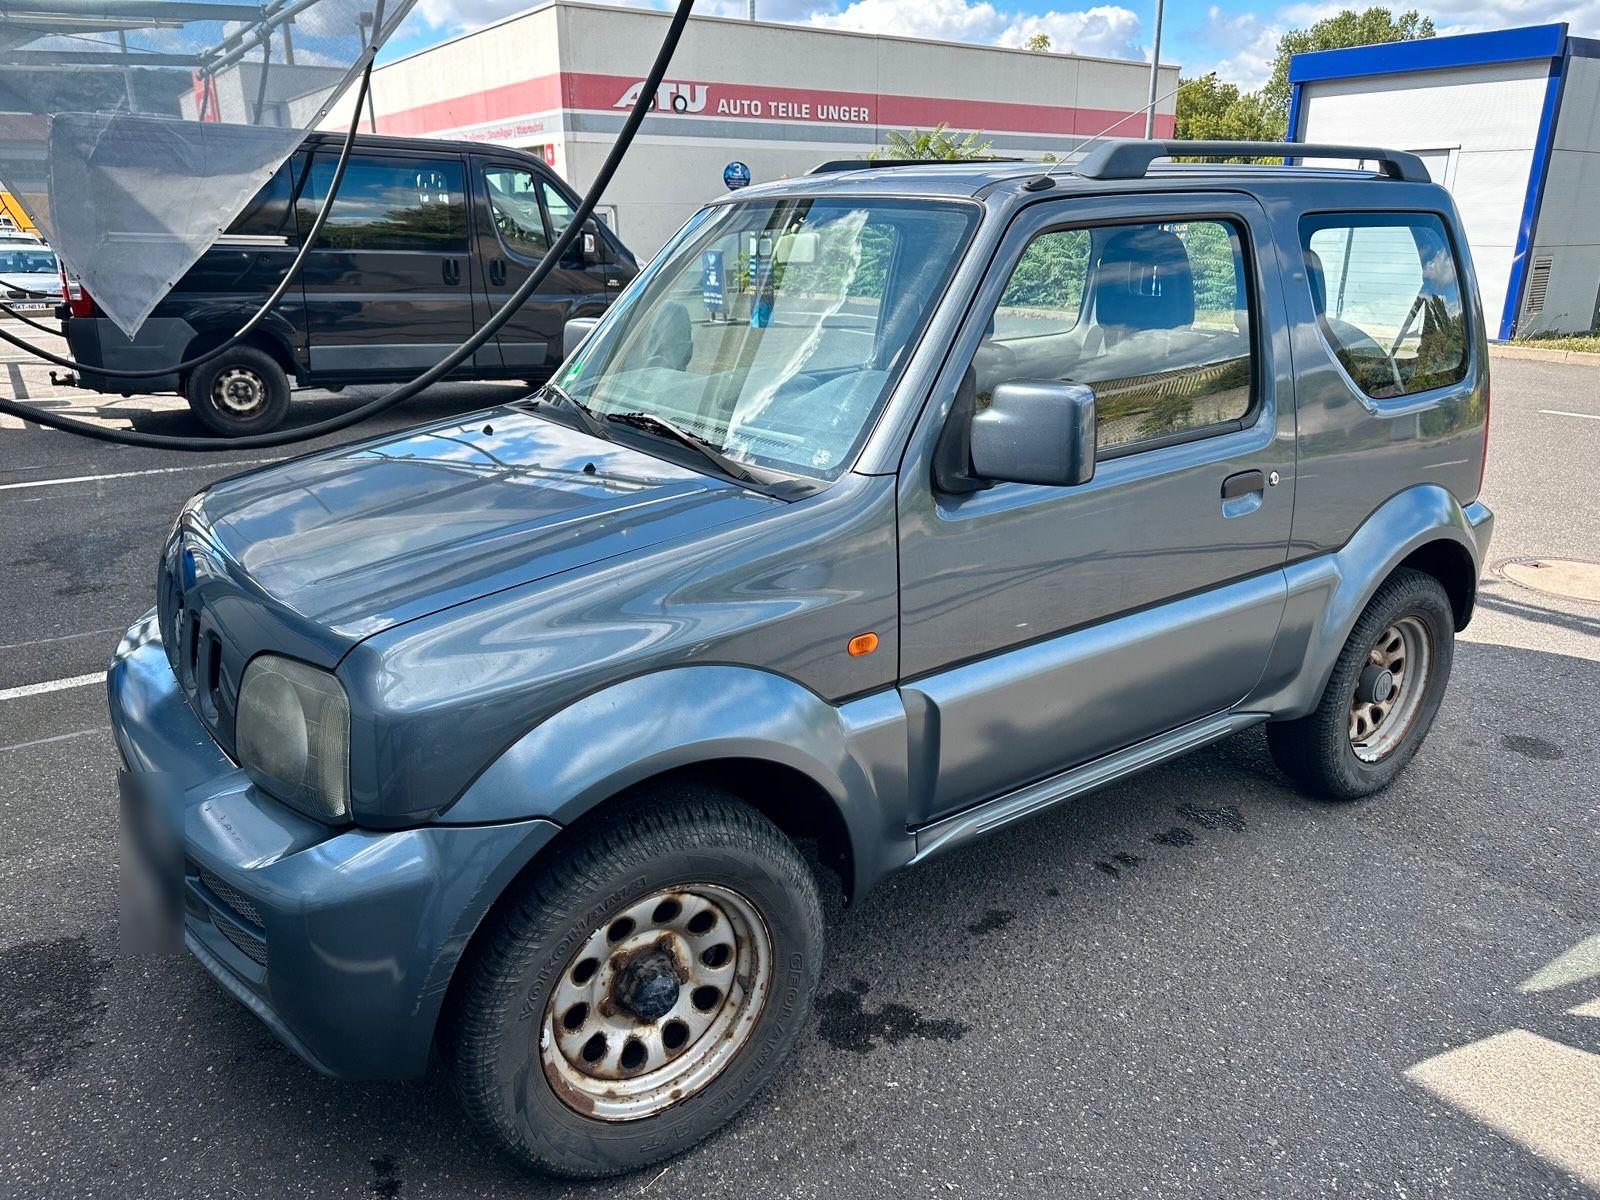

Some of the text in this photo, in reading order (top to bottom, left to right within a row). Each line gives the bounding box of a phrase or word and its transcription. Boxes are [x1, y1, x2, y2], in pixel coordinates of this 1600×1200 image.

[717, 98, 869, 122] AUTO TEILE UNGER
[733, 163, 742, 176] 3
[519, 875, 647, 1021] YOKOHAMA
[710, 952, 802, 1114] GEOLANDAR
